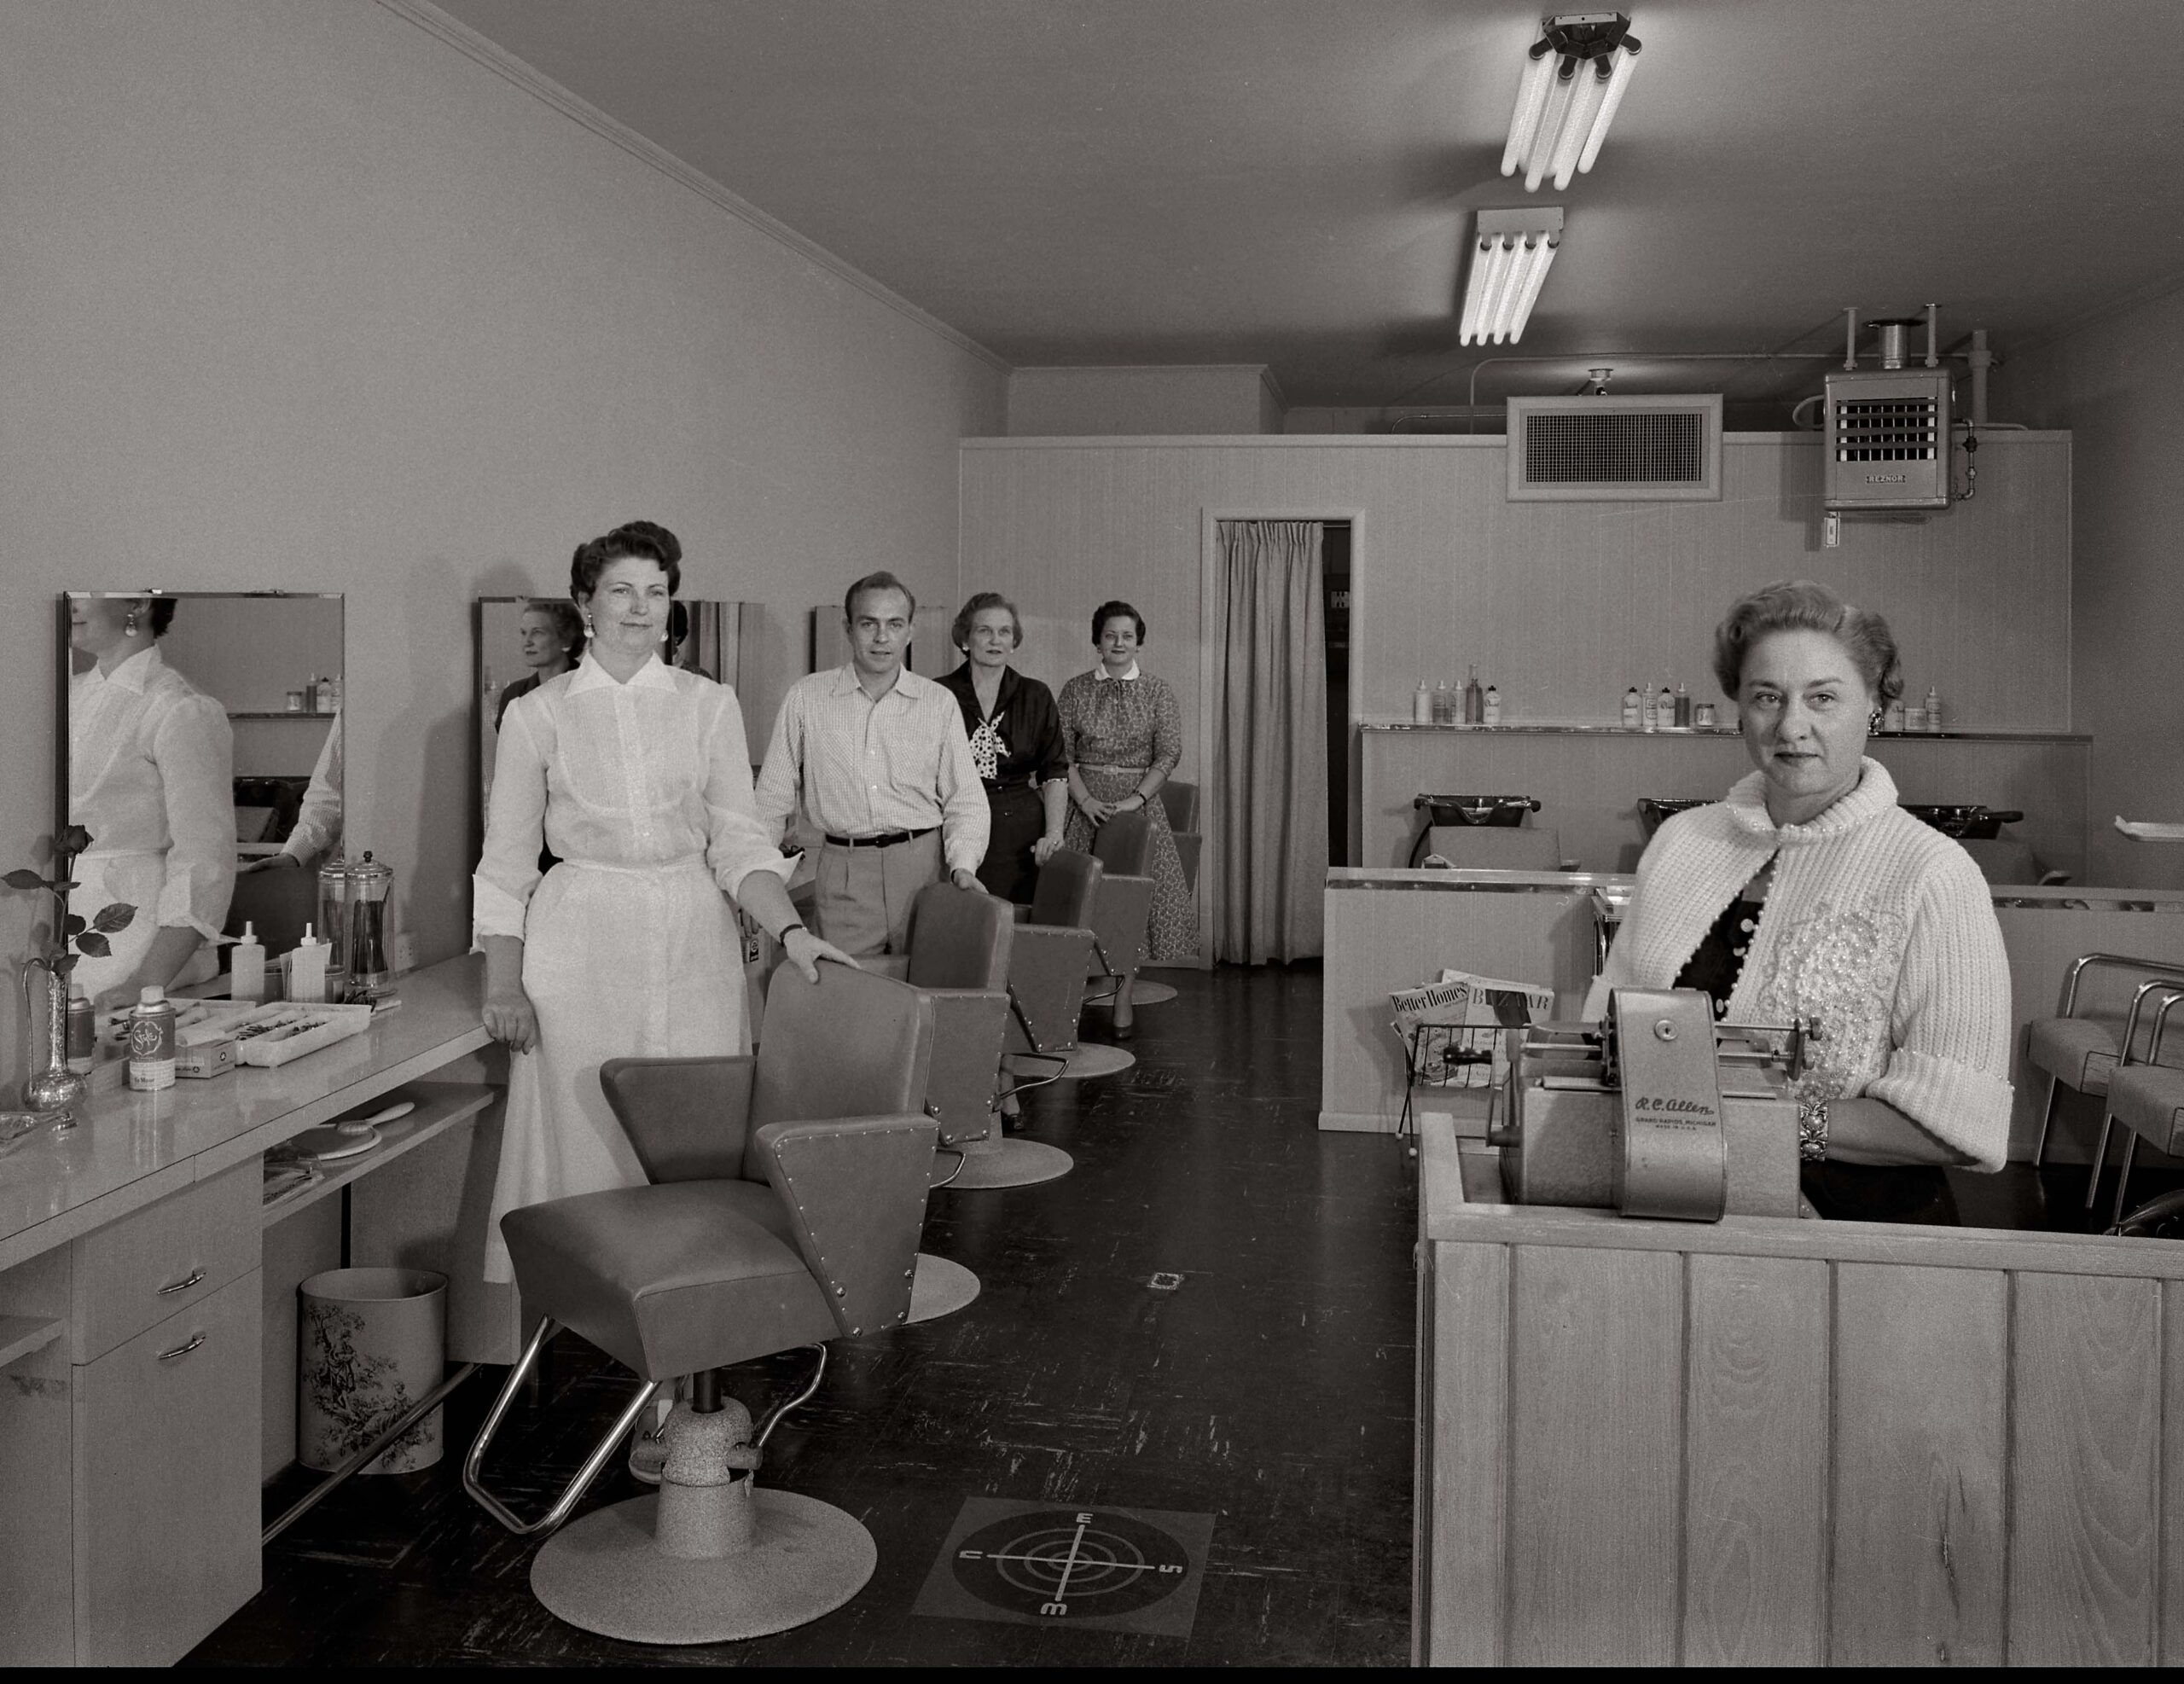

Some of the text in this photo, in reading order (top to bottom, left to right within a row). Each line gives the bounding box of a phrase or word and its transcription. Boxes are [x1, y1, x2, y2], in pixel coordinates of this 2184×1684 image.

[1392, 985, 1467, 1013] Better Homes
[133, 1028, 157, 1050] Style
[1076, 1513, 1094, 1524] E
